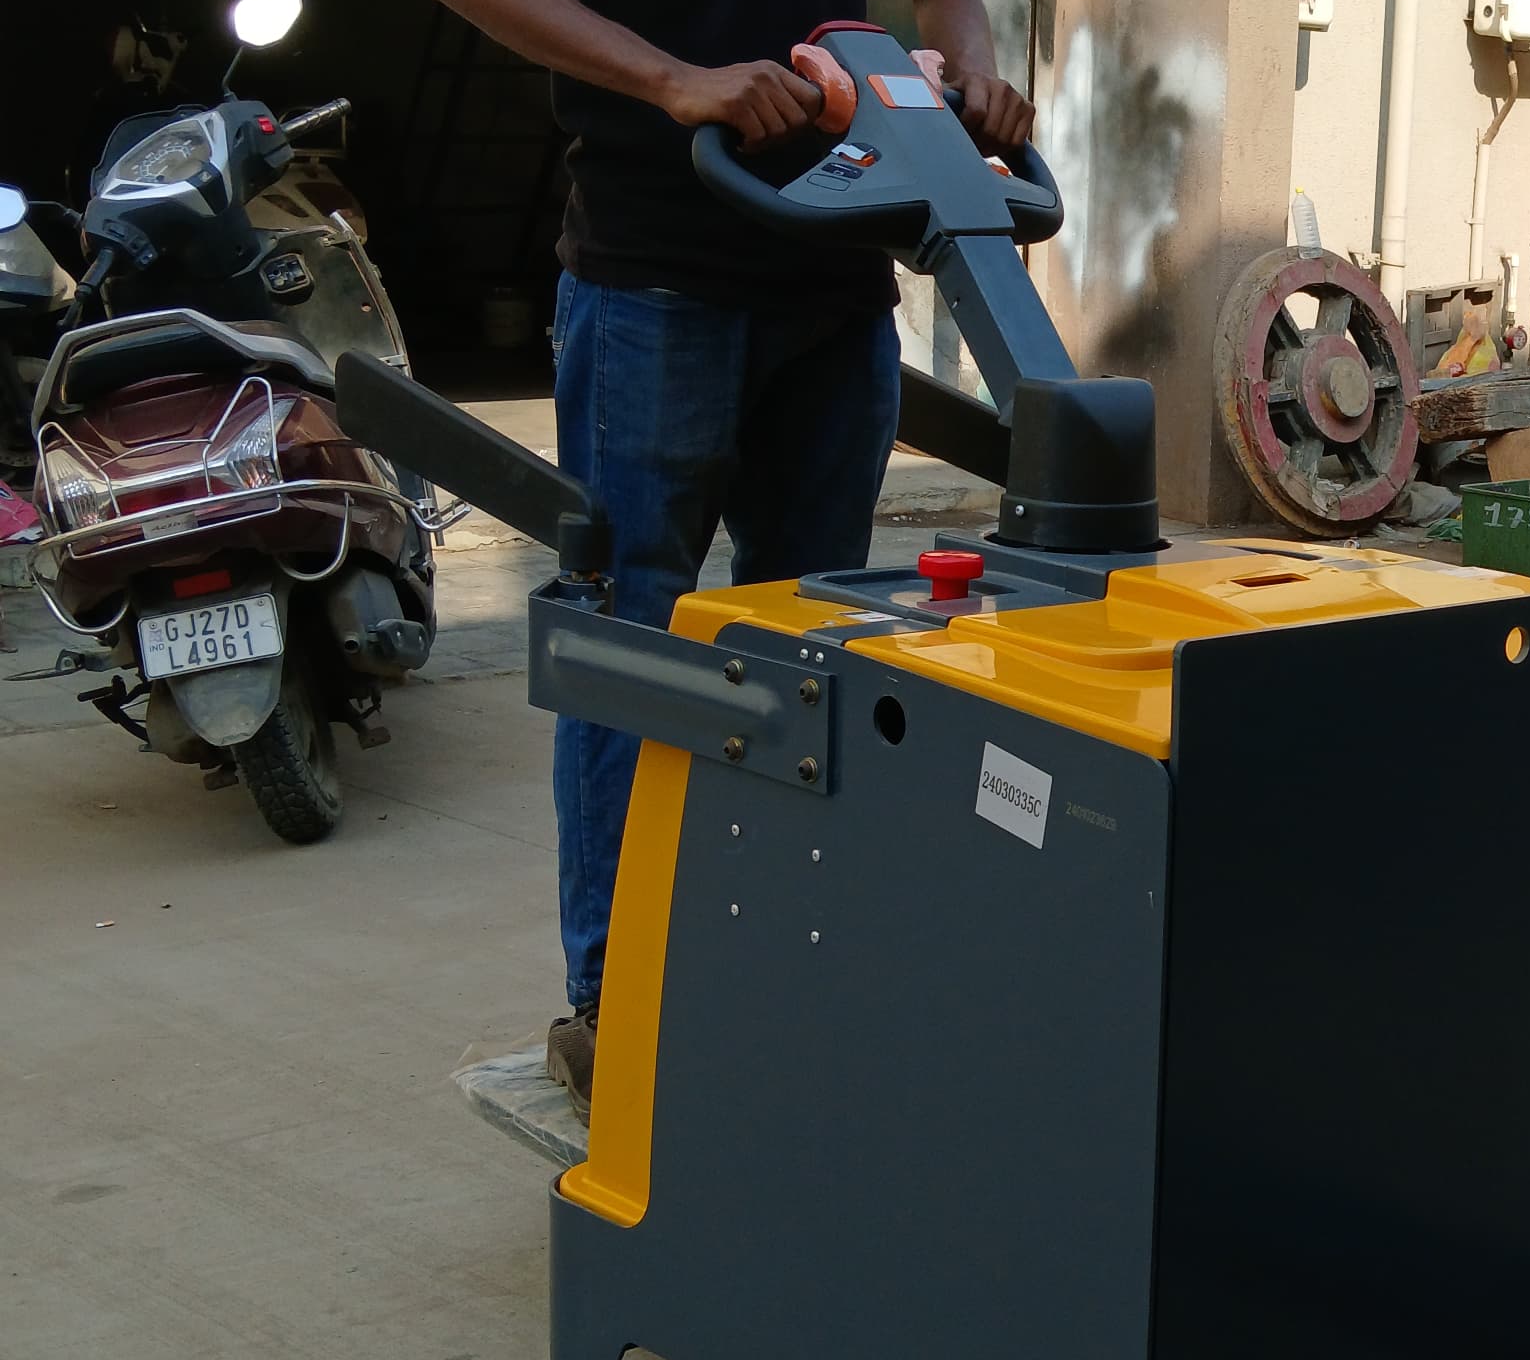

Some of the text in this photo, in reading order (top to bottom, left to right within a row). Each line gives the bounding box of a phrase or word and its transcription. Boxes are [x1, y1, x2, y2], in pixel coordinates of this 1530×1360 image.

[164, 603, 249, 642] GJ27D
[168, 630, 254, 670] L4961
[982, 770, 1042, 818] 24030335C
